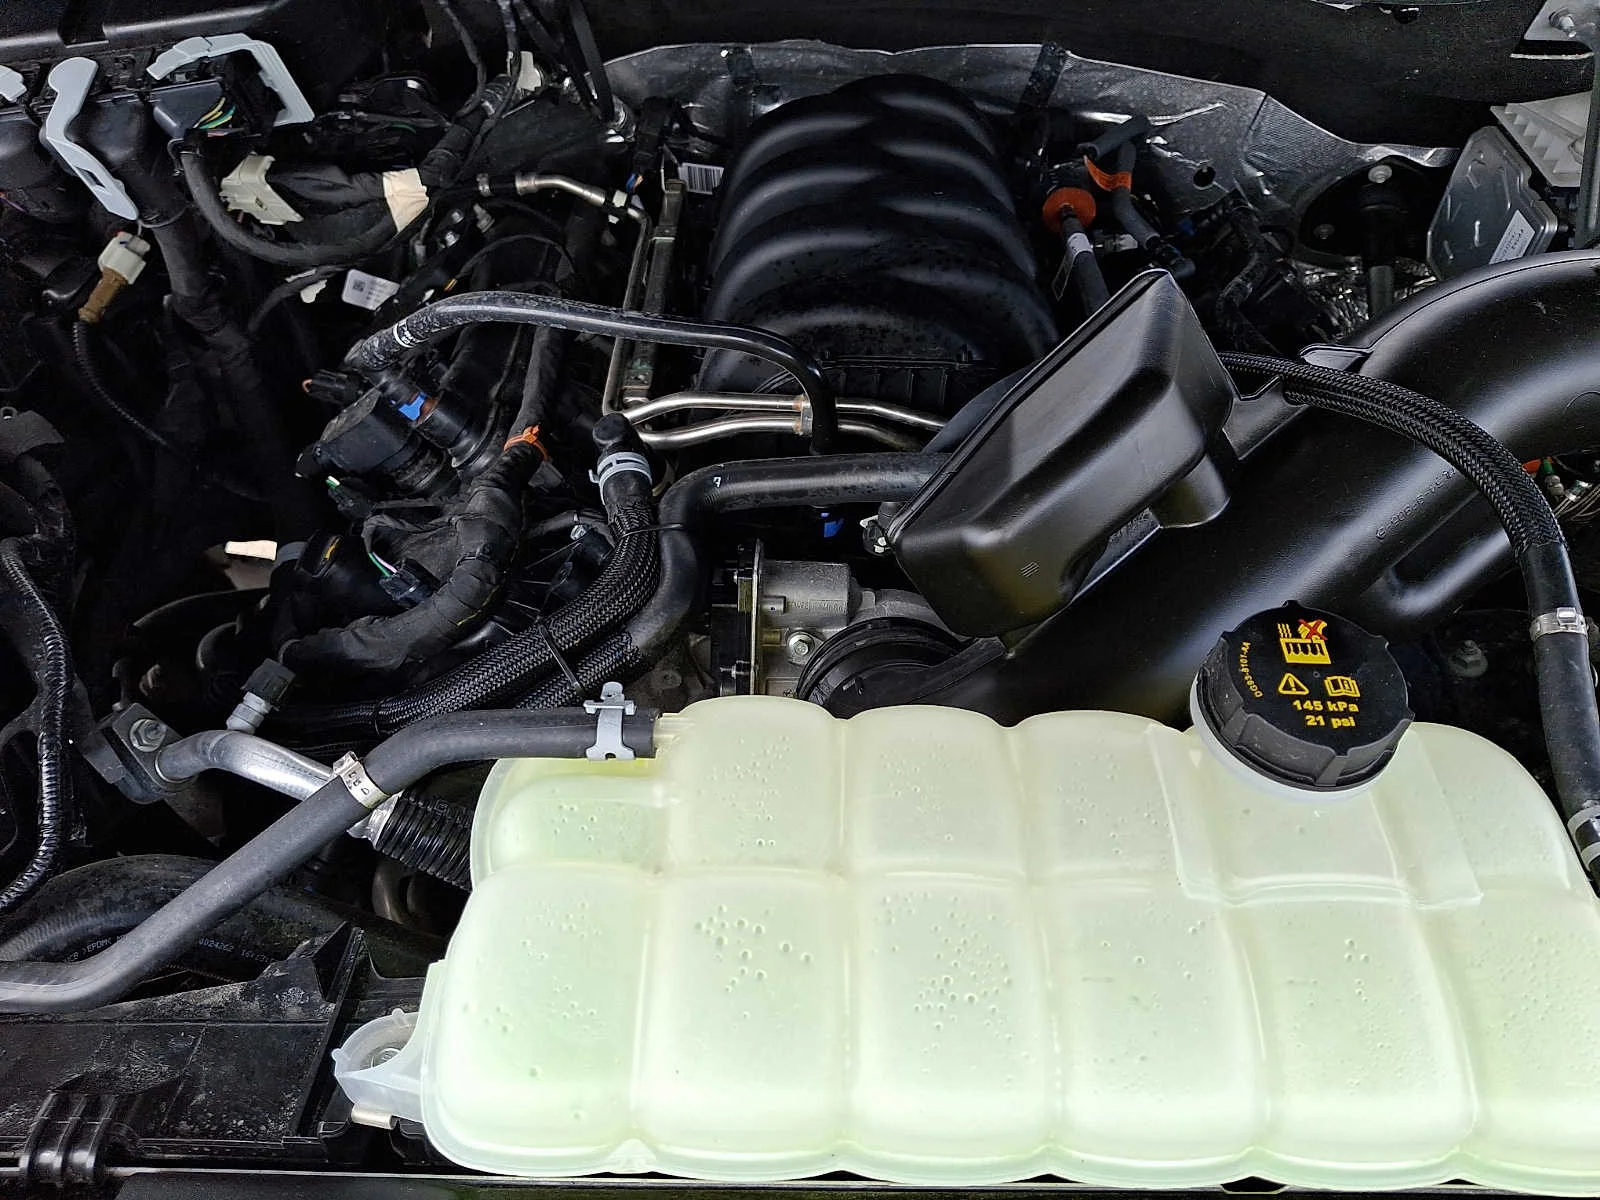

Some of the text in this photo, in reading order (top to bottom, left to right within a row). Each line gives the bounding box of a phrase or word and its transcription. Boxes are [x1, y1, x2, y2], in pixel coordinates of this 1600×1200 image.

[1292, 699, 1359, 712] 145 kPa
[1305, 714, 1356, 729] 21 psi
